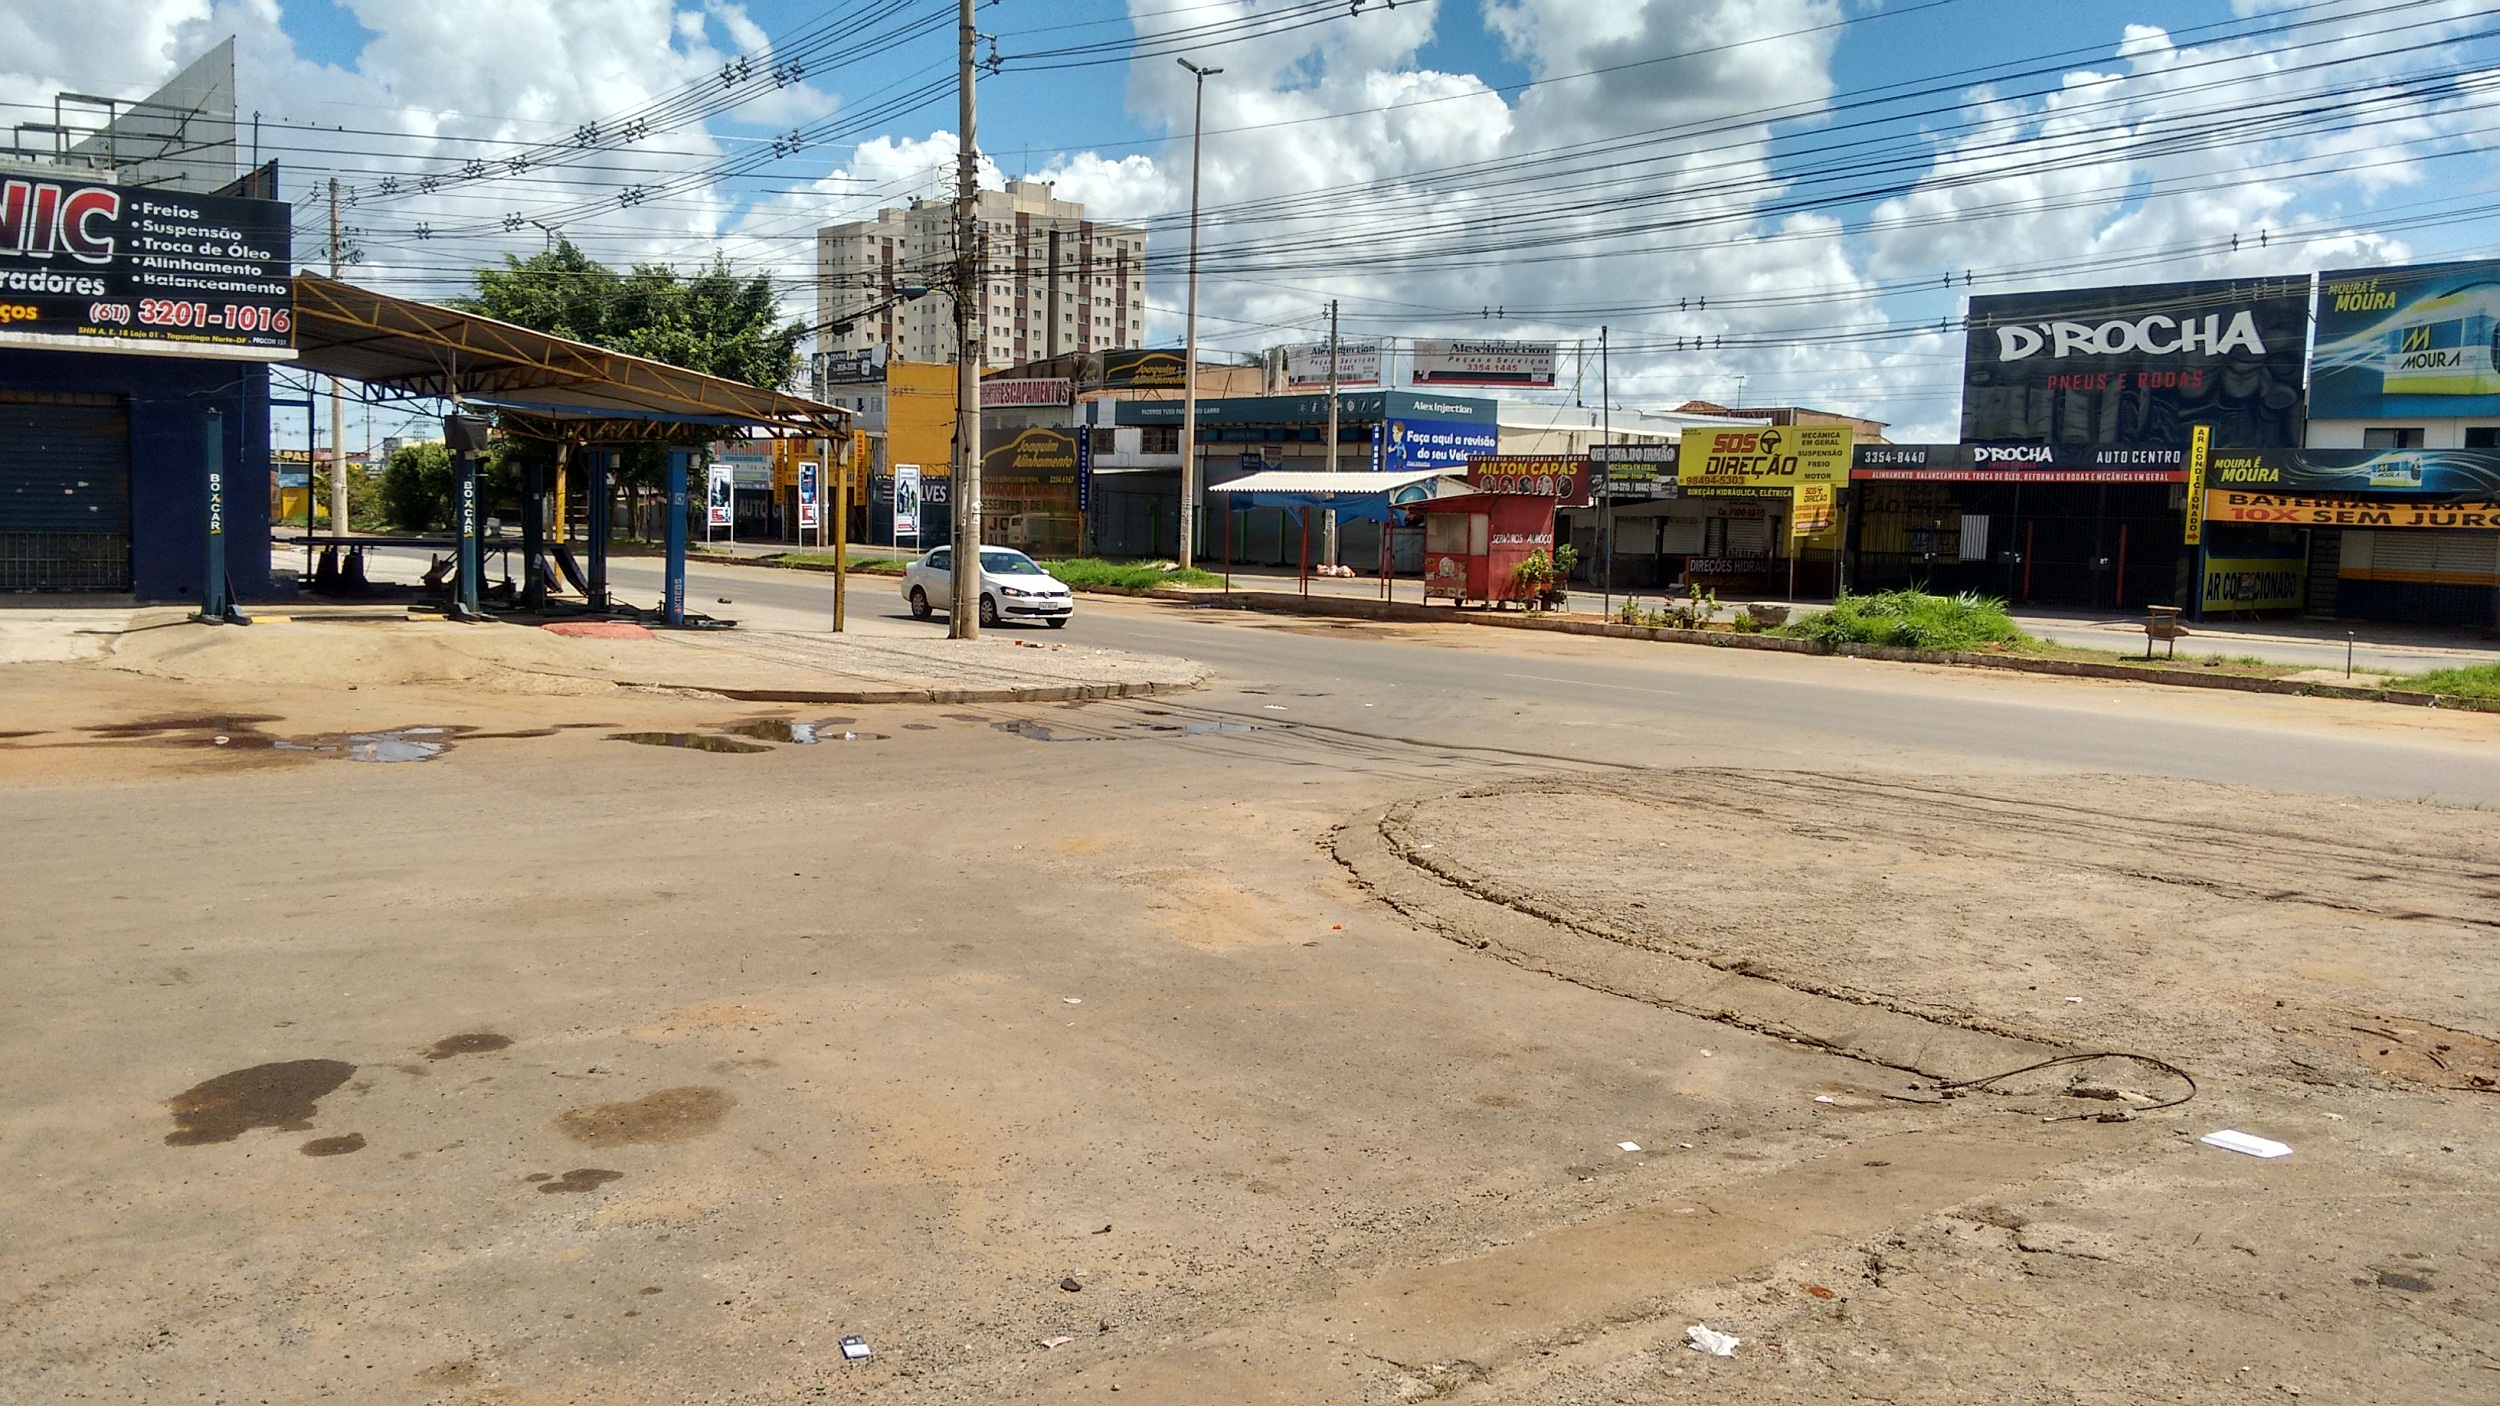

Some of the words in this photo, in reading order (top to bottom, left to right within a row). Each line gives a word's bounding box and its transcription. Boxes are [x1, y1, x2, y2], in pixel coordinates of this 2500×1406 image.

[143, 202, 200, 220] Freios
[143, 220, 242, 241] Suspensão
[143, 237, 193, 254] Troca
[199, 242, 222, 256] de
[228, 242, 271, 260] Óleo
[143, 256, 262, 276] Alinhamento
[143, 274, 287, 296] Balanceamento
[2328, 280, 2366, 296] MOURA
[2334, 292, 2396, 312] MOURA
[90, 302, 130, 326] (61)
[138, 299, 291, 333] 3201-1016
[78, 326, 96, 334] SHN
[130, 330, 147, 338] Loja
[167, 332, 210, 342] Taguatinga
[212, 335, 247, 344] Norte-DF
[253, 336, 276, 344] PROCON
[1996, 310, 2266, 362] D'ROCHA
[1337, 344, 1375, 355] njection
[1322, 364, 1355, 374] 33-1445
[1448, 356, 1482, 364] Peças
[1496, 356, 1549, 365] Serviços
[1467, 364, 1518, 372] 3354-1445
[2401, 351, 2461, 370] MOURA
[1135, 364, 1177, 376] Joaquim
[1130, 375, 1187, 386] Alinhament
[2048, 373, 2106, 390] PNEUS
[2118, 373, 2126, 388] E
[2138, 371, 2203, 388] RODAS
[1000, 381, 1068, 405] ESCAPAMENTOS
[1413, 401, 1433, 411] Alex
[1434, 402, 1473, 414] Injection
[1407, 430, 1430, 445] Faça
[1432, 433, 1454, 446] aqui
[1455, 437, 1463, 446] a
[1463, 434, 1496, 448] revisão
[1712, 433, 1760, 454] SOS
[1801, 431, 1841, 439] MECÂNICA
[2197, 429, 2205, 442] AR
[1017, 439, 1059, 458] Joaquim
[1417, 448, 1429, 459] do
[1431, 452, 1447, 461] seu
[1629, 447, 1643, 462] DO
[1643, 445, 1676, 462] IRMÃO
[1797, 449, 1843, 457] SUSPENSÃO
[1865, 451, 1925, 463] 3354-8440
[1974, 446, 2053, 463] D'ROCHA
[2096, 451, 2128, 464] AUTO
[2132, 450, 2181, 464] CENTRO
[1012, 454, 1074, 468] Alinhamento
[1478, 463, 1527, 475] AILTON
[1530, 462, 1578, 475] CAPAS
[1704, 453, 1798, 479] DIREÇÃO
[2214, 458, 2252, 469] MOURA
[2254, 457, 2262, 468] É
[1686, 476, 1745, 485] 98494-5303
[2024, 473, 2054, 481] REFORMA
[2097, 471, 2132, 481] MECÂNICA
[2134, 473, 2144, 481] EM
[2146, 473, 2169, 481] GERAL
[2221, 469, 2280, 483] MOURA
[1687, 487, 1714, 497] DIREÇÃO
[1716, 487, 1758, 498] HIDRÁULICA,
[1760, 487, 1792, 498] ELÉTRICA
[2189, 446, 2204, 532] CONDICIONADO
[210, 473, 221, 530] BOXCAR
[464, 481, 473, 533] BOXCAR
[739, 499, 767, 517] AUTO
[2230, 507, 2300, 522] 10X
[2312, 510, 2392, 525] SEM
[1690, 559, 1732, 574] DIREÇÕES
[2206, 572, 2221, 601] AR
[2223, 571, 2297, 601] COCIONADO
